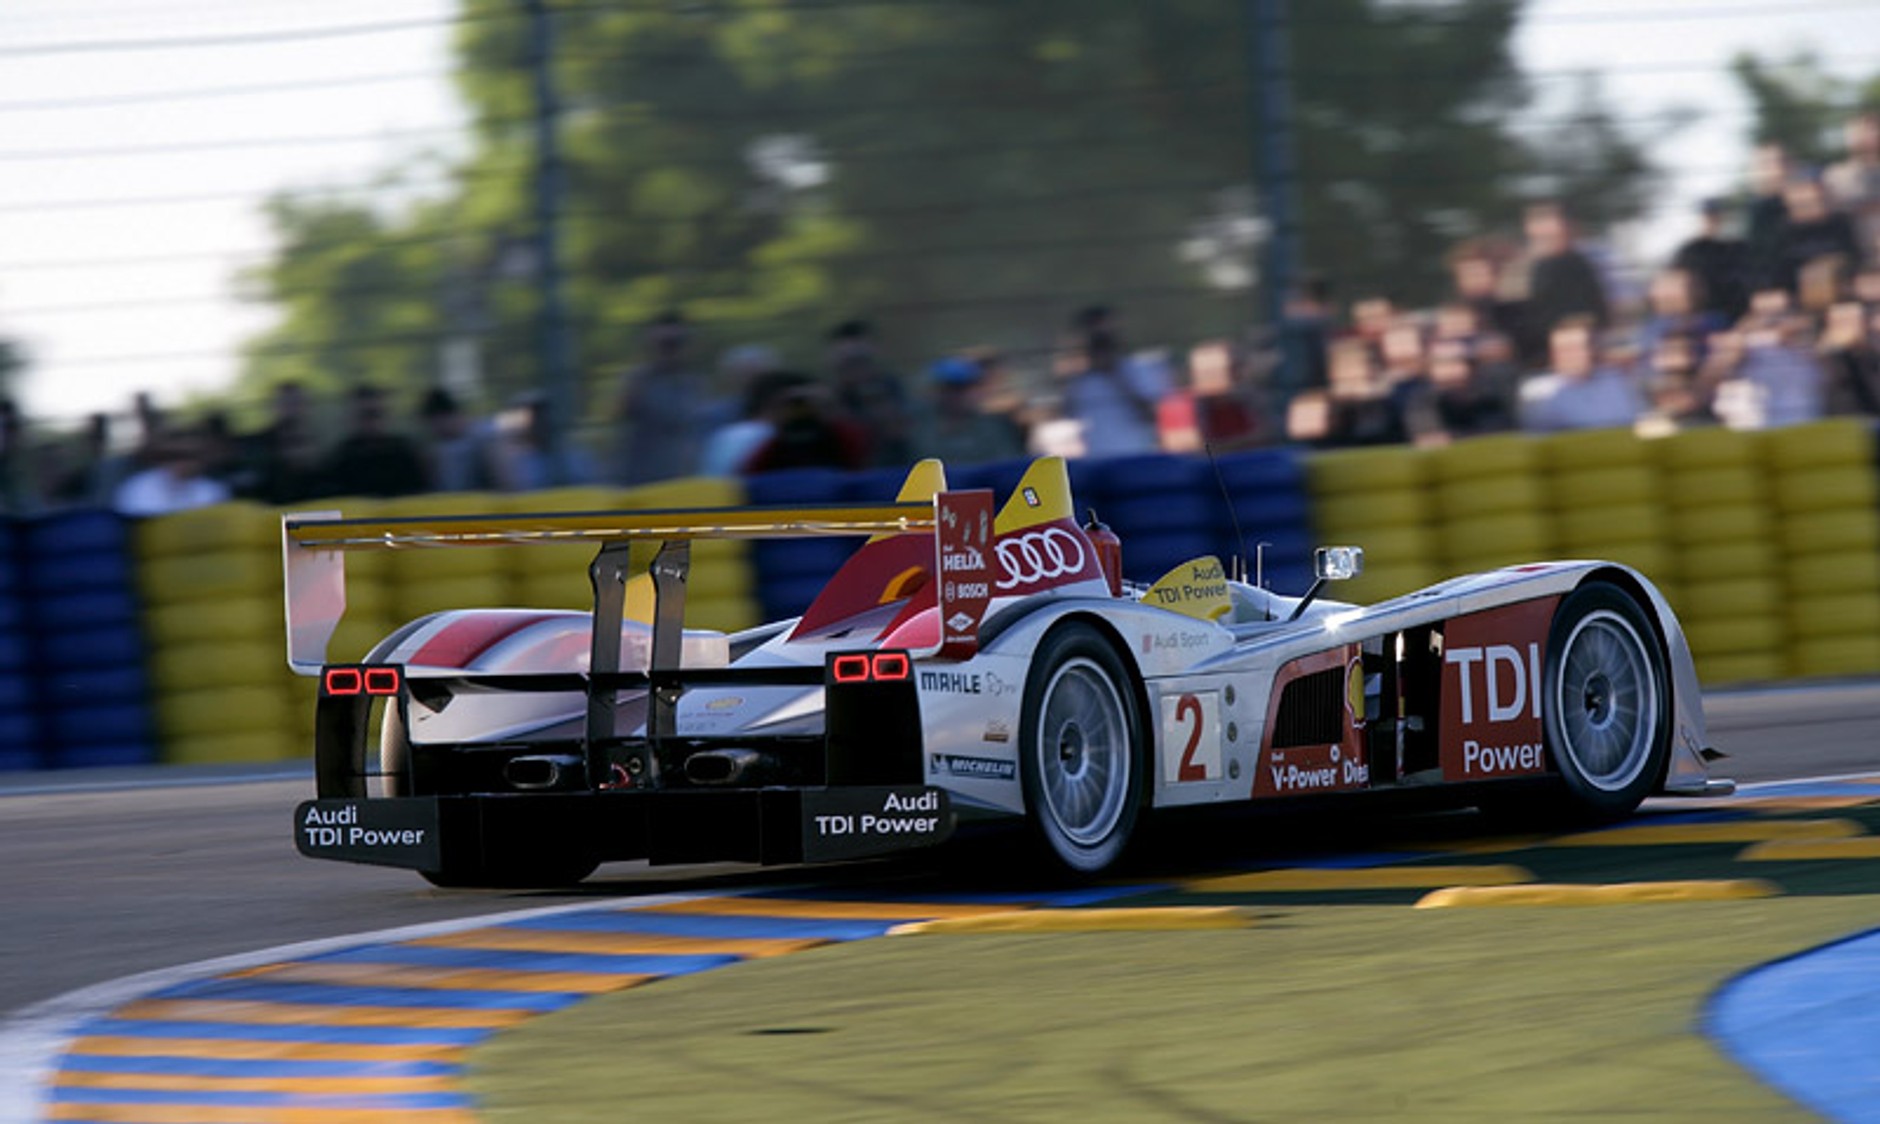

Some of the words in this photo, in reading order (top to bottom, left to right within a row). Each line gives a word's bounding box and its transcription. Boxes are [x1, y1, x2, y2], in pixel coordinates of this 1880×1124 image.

[957, 583, 988, 598] BOSCH
[1154, 586, 1181, 603] TDI
[1183, 584, 1227, 600] Power
[921, 672, 981, 694] MAHLE
[1445, 643, 1542, 723] TDI
[1175, 692, 1207, 782] 2
[1463, 740, 1543, 773] Power
[1271, 764, 1338, 791] V-Power
[885, 791, 938, 811] Audi
[305, 805, 357, 825] Audi
[815, 815, 854, 834] TDI
[861, 814, 938, 834] Power
[305, 827, 342, 846] TDI
[349, 827, 424, 846] Power
